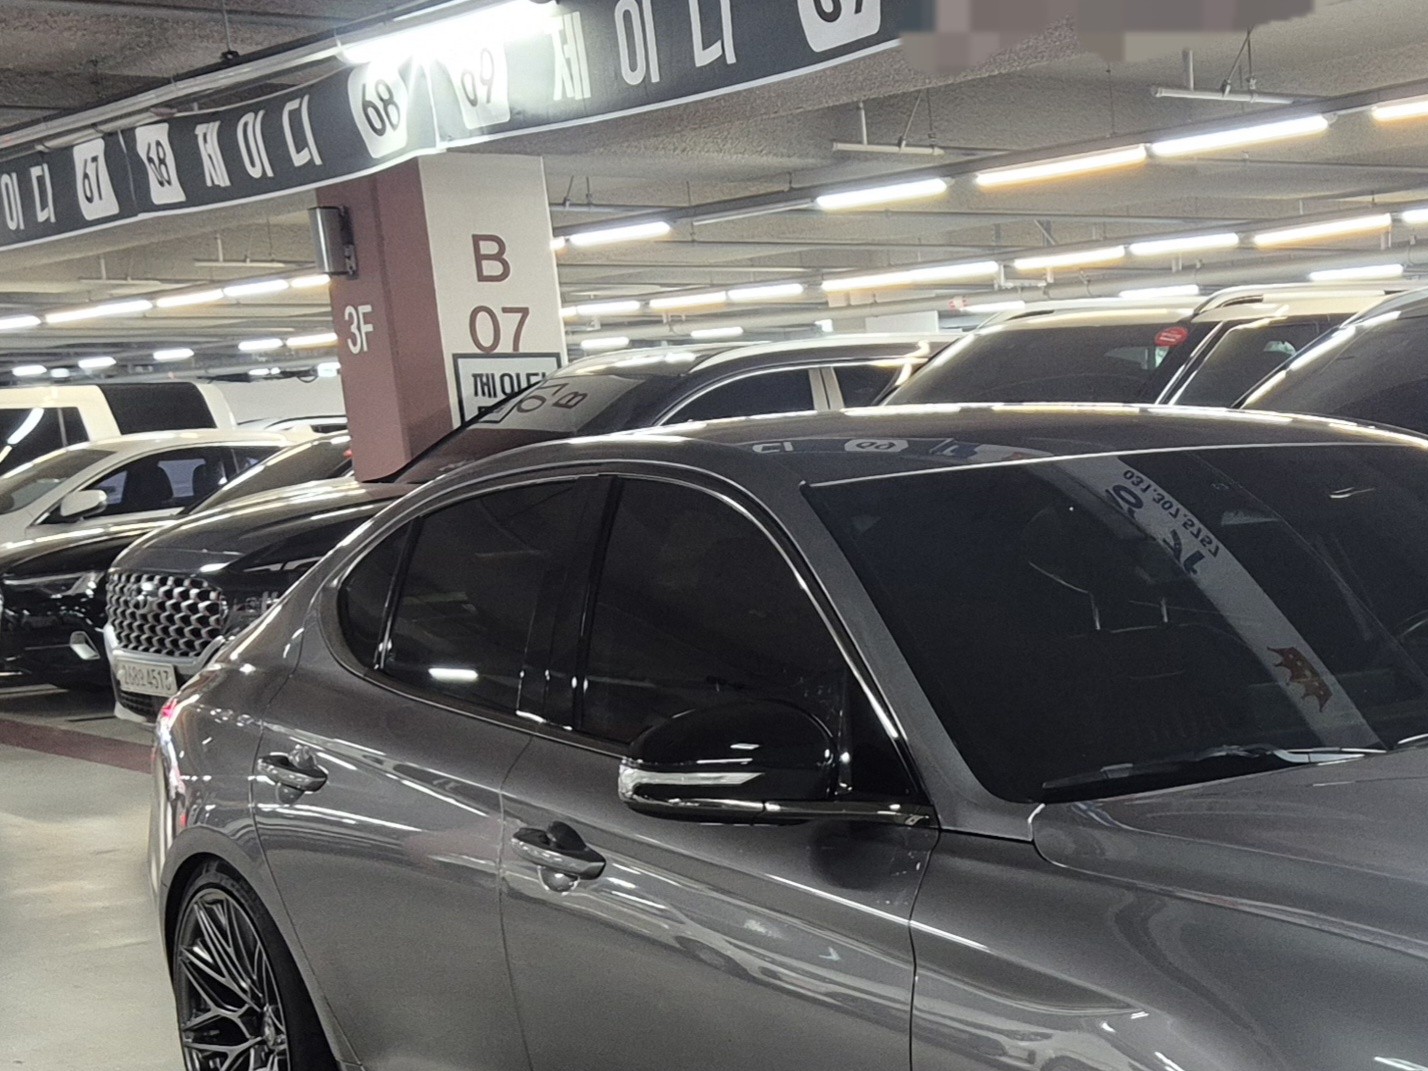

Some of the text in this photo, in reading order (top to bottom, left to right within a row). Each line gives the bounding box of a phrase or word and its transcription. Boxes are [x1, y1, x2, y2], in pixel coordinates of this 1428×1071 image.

[147, 79, 400, 189] 68 제이디 68
[81, 155, 99, 204] 67
[472, 233, 511, 282] B
[344, 304, 374, 354] 3F
[469, 305, 530, 353] 07
